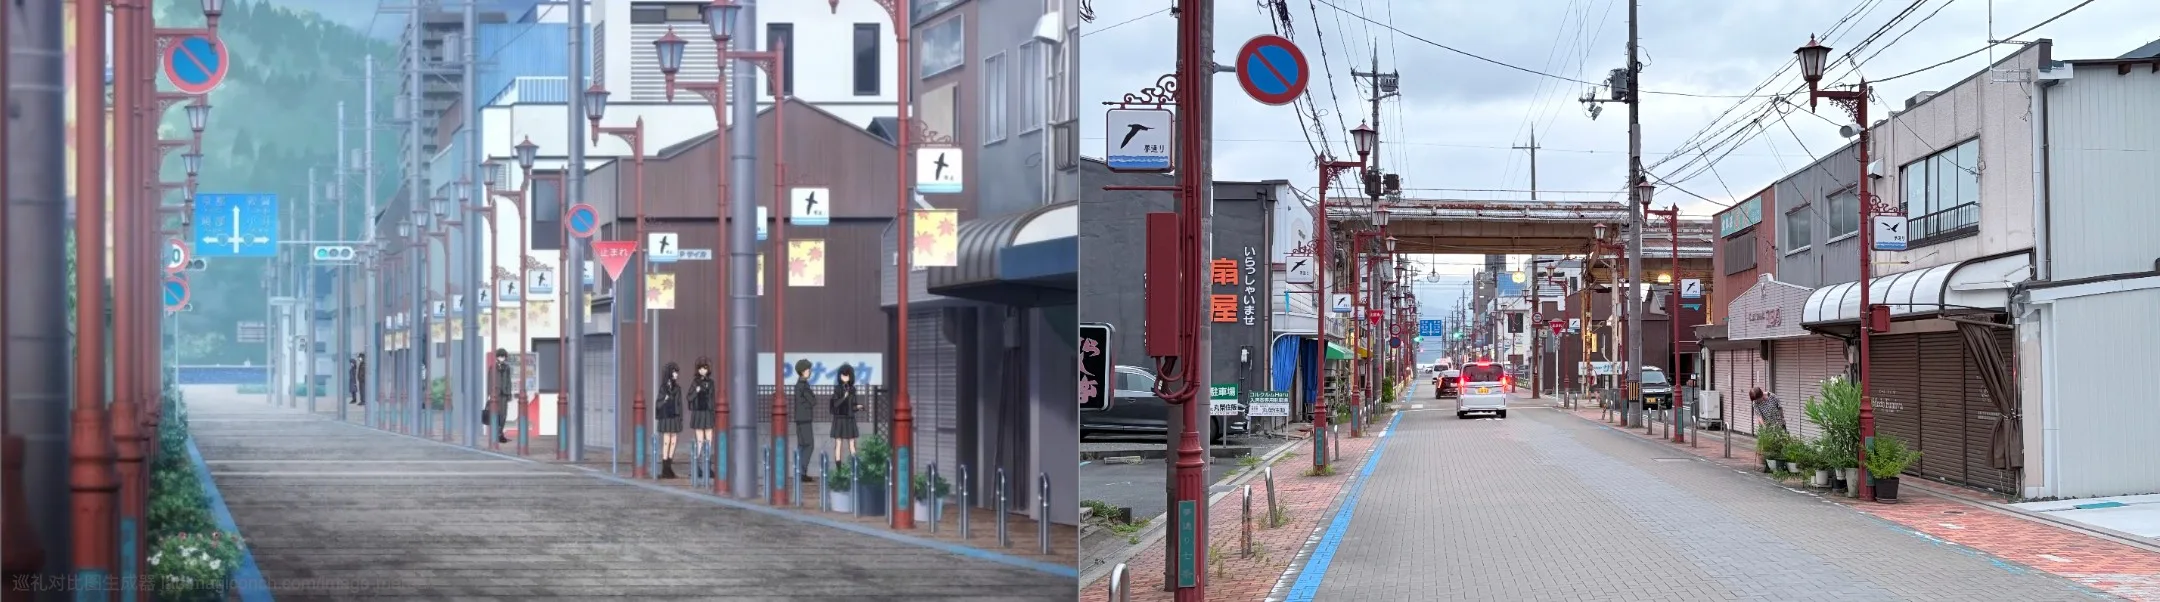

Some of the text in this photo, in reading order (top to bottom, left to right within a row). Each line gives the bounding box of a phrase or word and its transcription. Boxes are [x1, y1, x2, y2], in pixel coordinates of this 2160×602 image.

[600, 248, 628, 257] 止まれ
[1211, 257, 1239, 322] 扇屋
[1243, 246, 1256, 326] いらっしゃいませ
